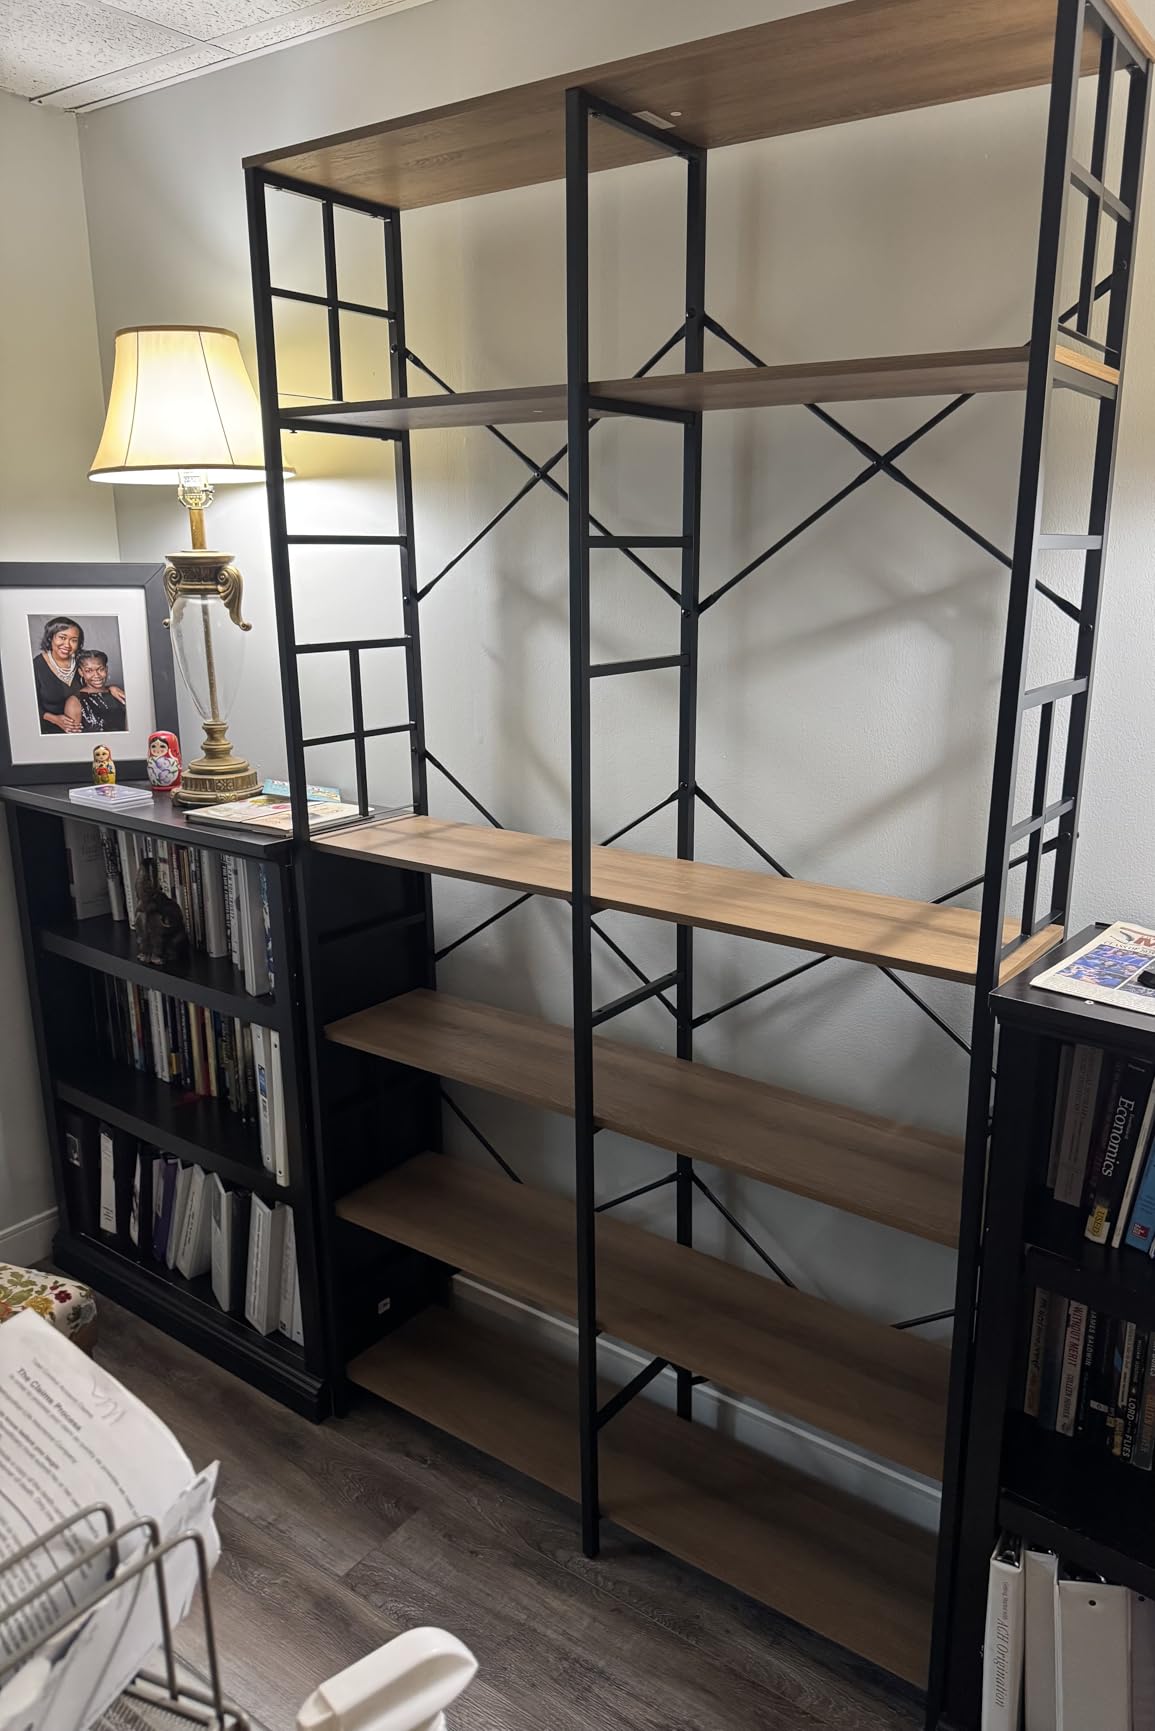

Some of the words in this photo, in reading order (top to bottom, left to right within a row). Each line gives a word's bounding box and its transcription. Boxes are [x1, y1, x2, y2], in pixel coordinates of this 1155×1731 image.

[1102, 1096, 1134, 1177] Economics
[1092, 1213, 1104, 1234] USED
[1070, 1306, 1081, 1340] WITHOUT
[1088, 1311, 1096, 1332] JAMES
[1067, 1341, 1078, 1366] MERIT
[1085, 1335, 1094, 1365] BALDWIN
[16, 1366, 32, 1382] The
[29, 1378, 56, 1405] Claims
[53, 1401, 84, 1431] Process
[1126, 1397, 1136, 1420] LORD
[1122, 1433, 1131, 1457] FLIES
[996, 1618, 1009, 1642] ACH
[993, 1643, 1008, 1707] Origination
